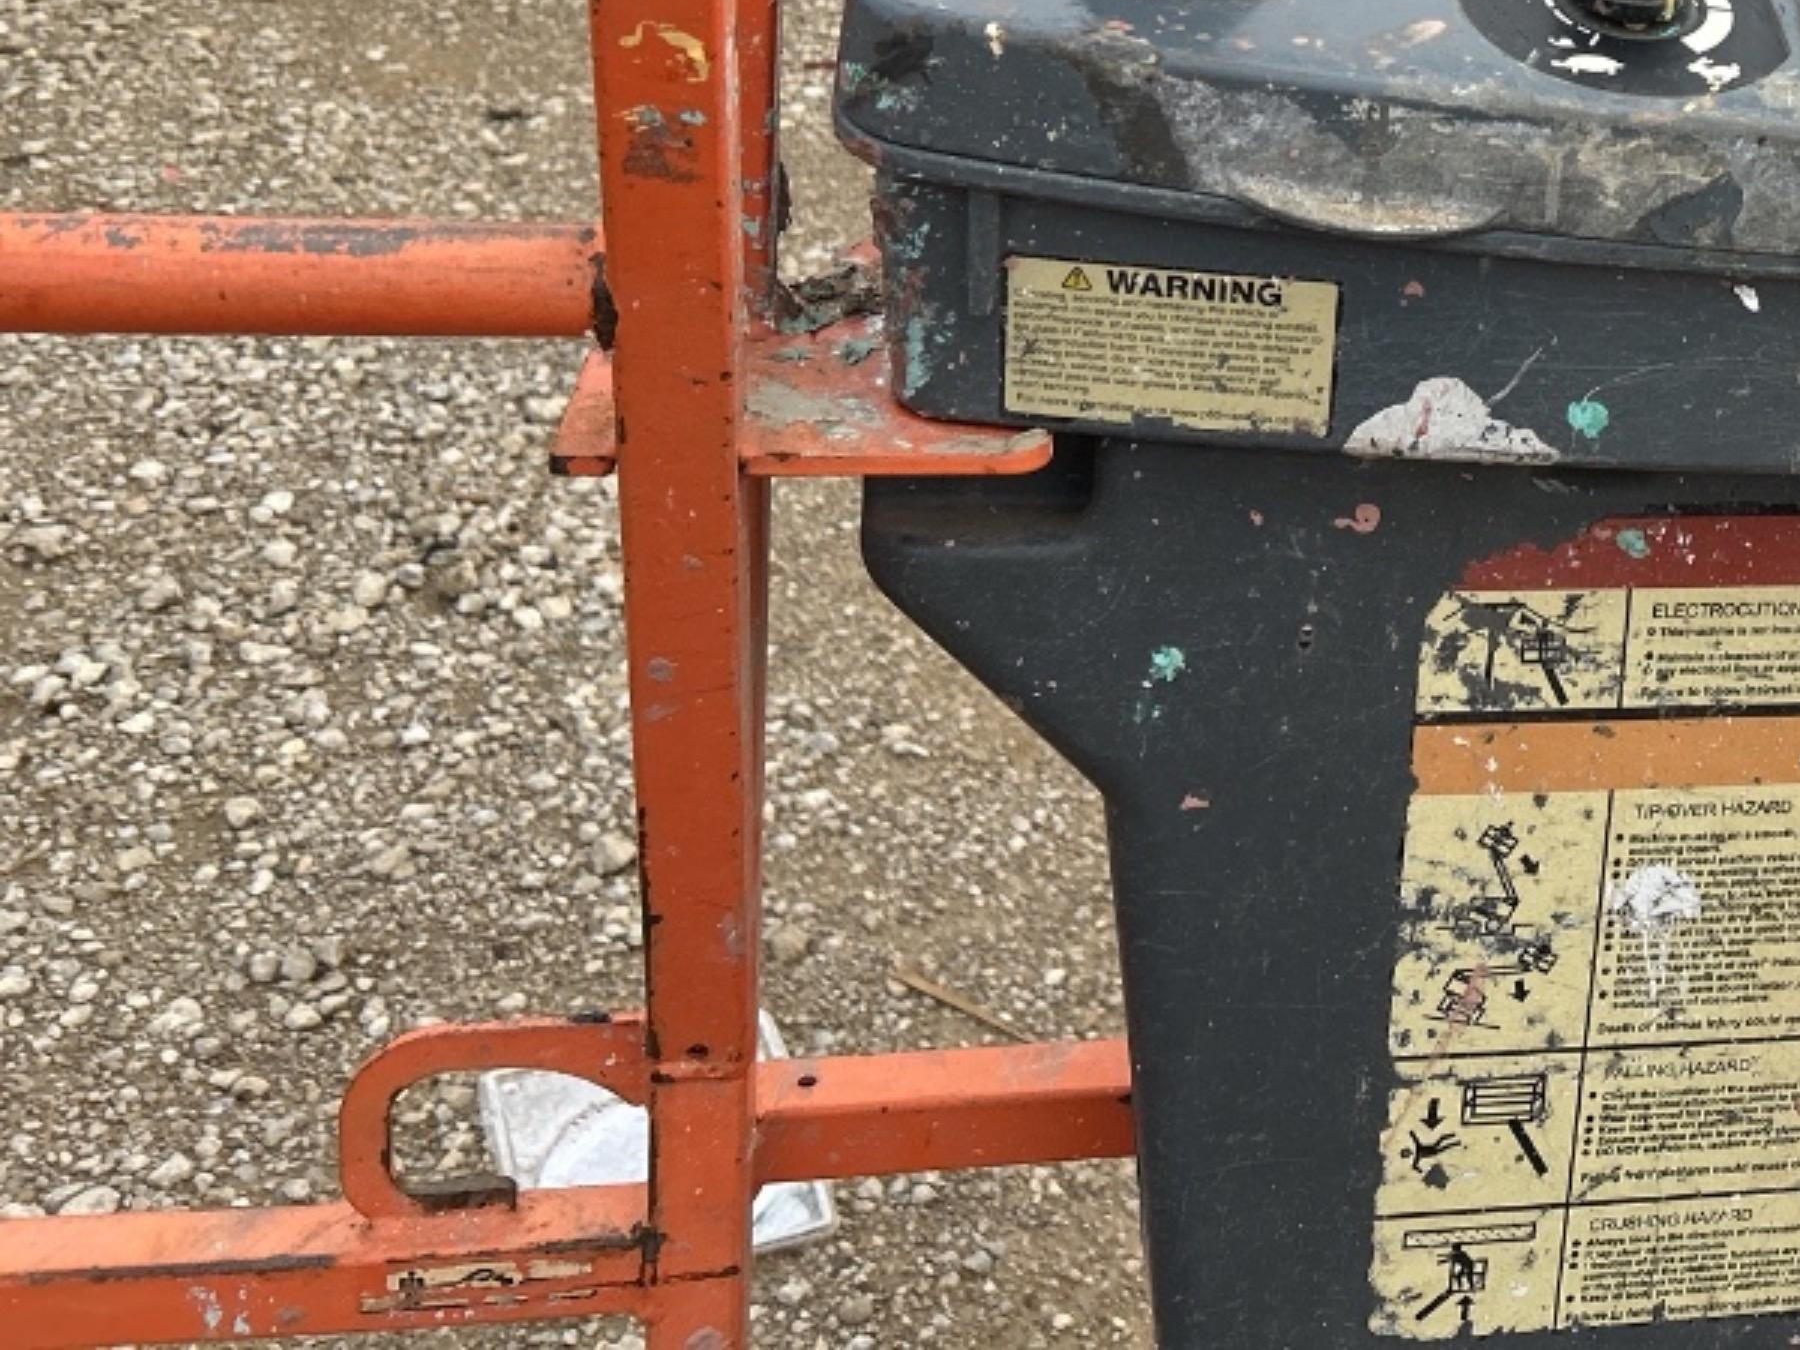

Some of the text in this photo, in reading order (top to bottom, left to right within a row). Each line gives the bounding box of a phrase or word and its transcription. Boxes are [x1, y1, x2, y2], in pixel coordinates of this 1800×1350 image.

[1106, 269, 1282, 307] WARNING
[1721, 799, 1793, 817] HAZARD
[1680, 1059, 1752, 1077] HAZARD
